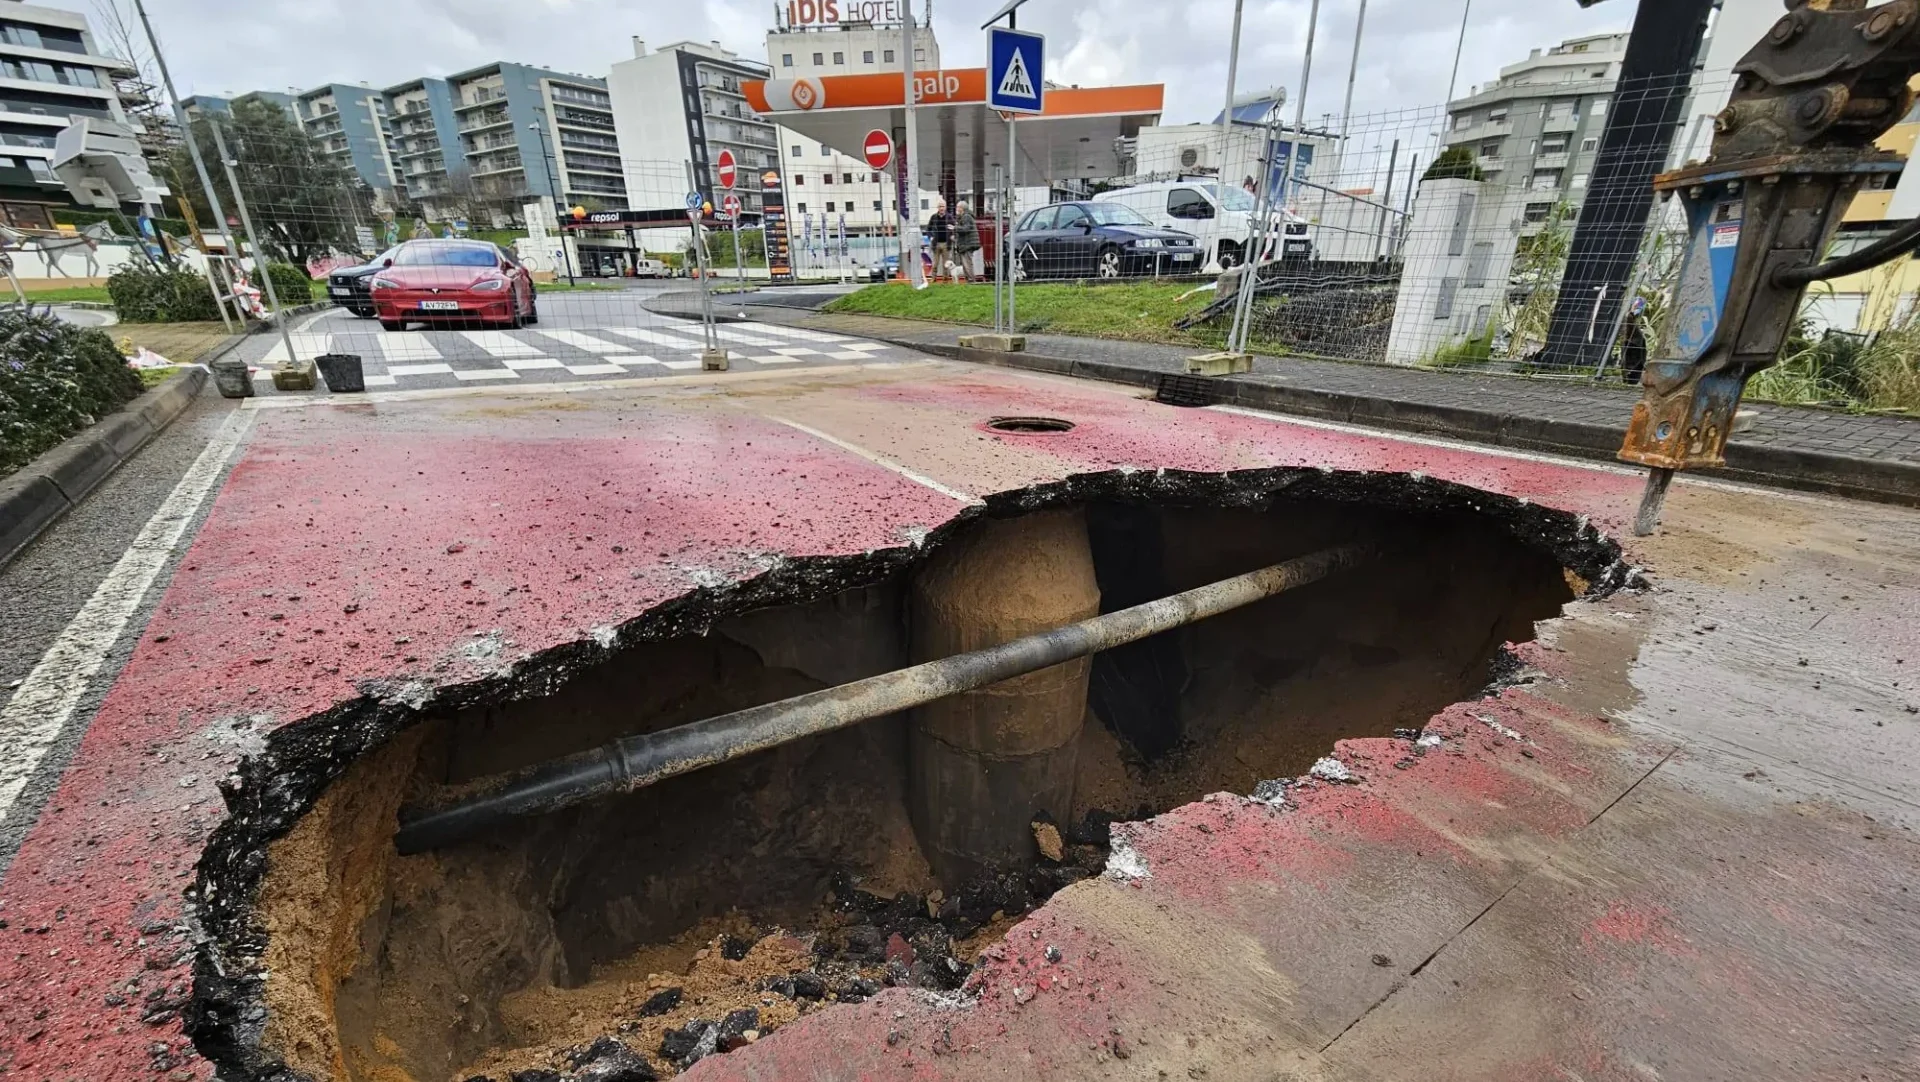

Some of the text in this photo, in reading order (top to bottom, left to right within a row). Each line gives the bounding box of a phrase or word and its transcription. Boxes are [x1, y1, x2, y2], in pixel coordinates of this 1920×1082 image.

[790, 0, 904, 25] ibis HOTEL
[913, 71, 960, 101] galp
[590, 212, 620, 223] repsol
